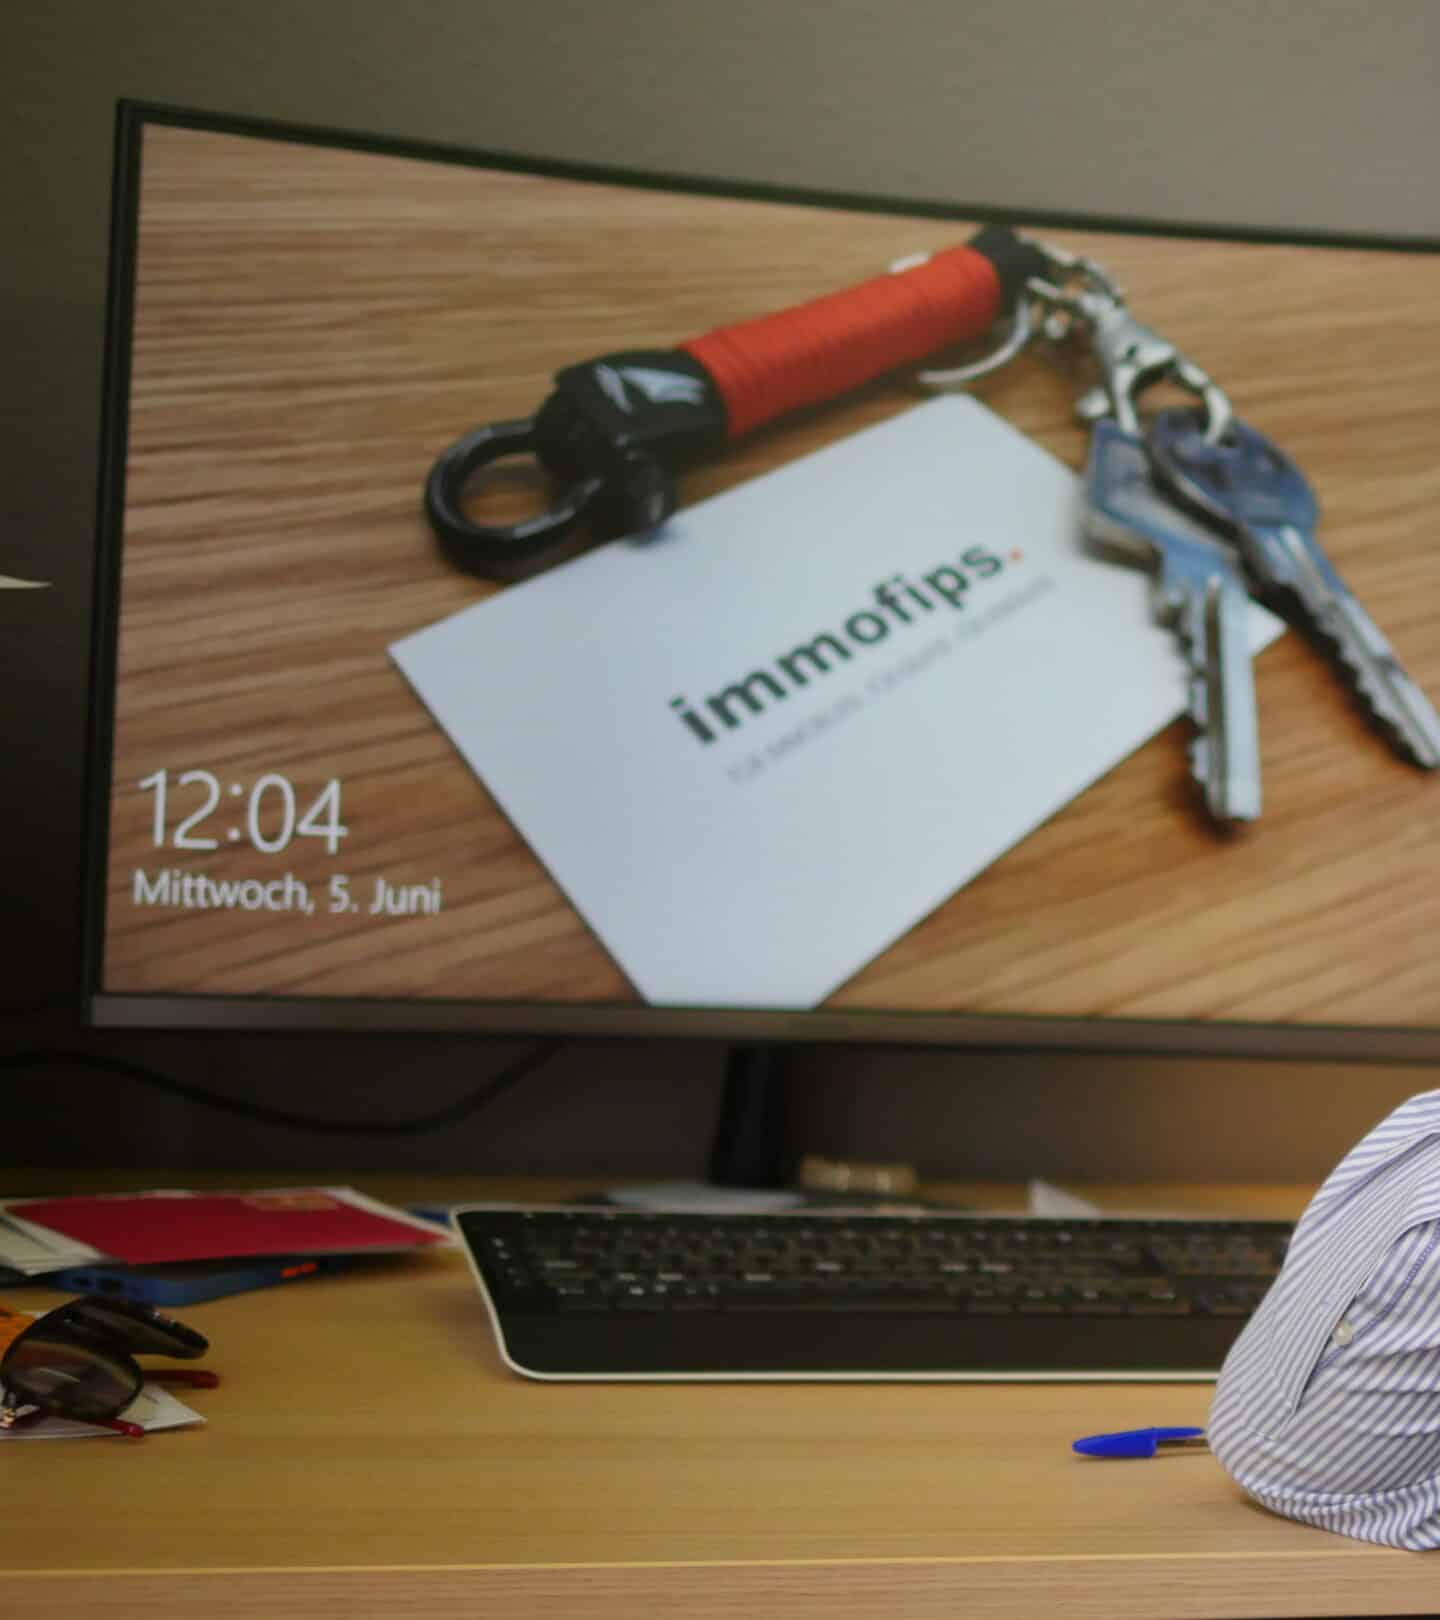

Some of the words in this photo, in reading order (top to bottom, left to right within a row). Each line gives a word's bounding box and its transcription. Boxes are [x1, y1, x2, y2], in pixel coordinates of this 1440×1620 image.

[669, 543, 1024, 745] immofips.
[138, 769, 348, 855] 12:04
[133, 869, 315, 915] Mittwoch,
[329, 875, 358, 914] 5.
[369, 878, 441, 915] Juni
